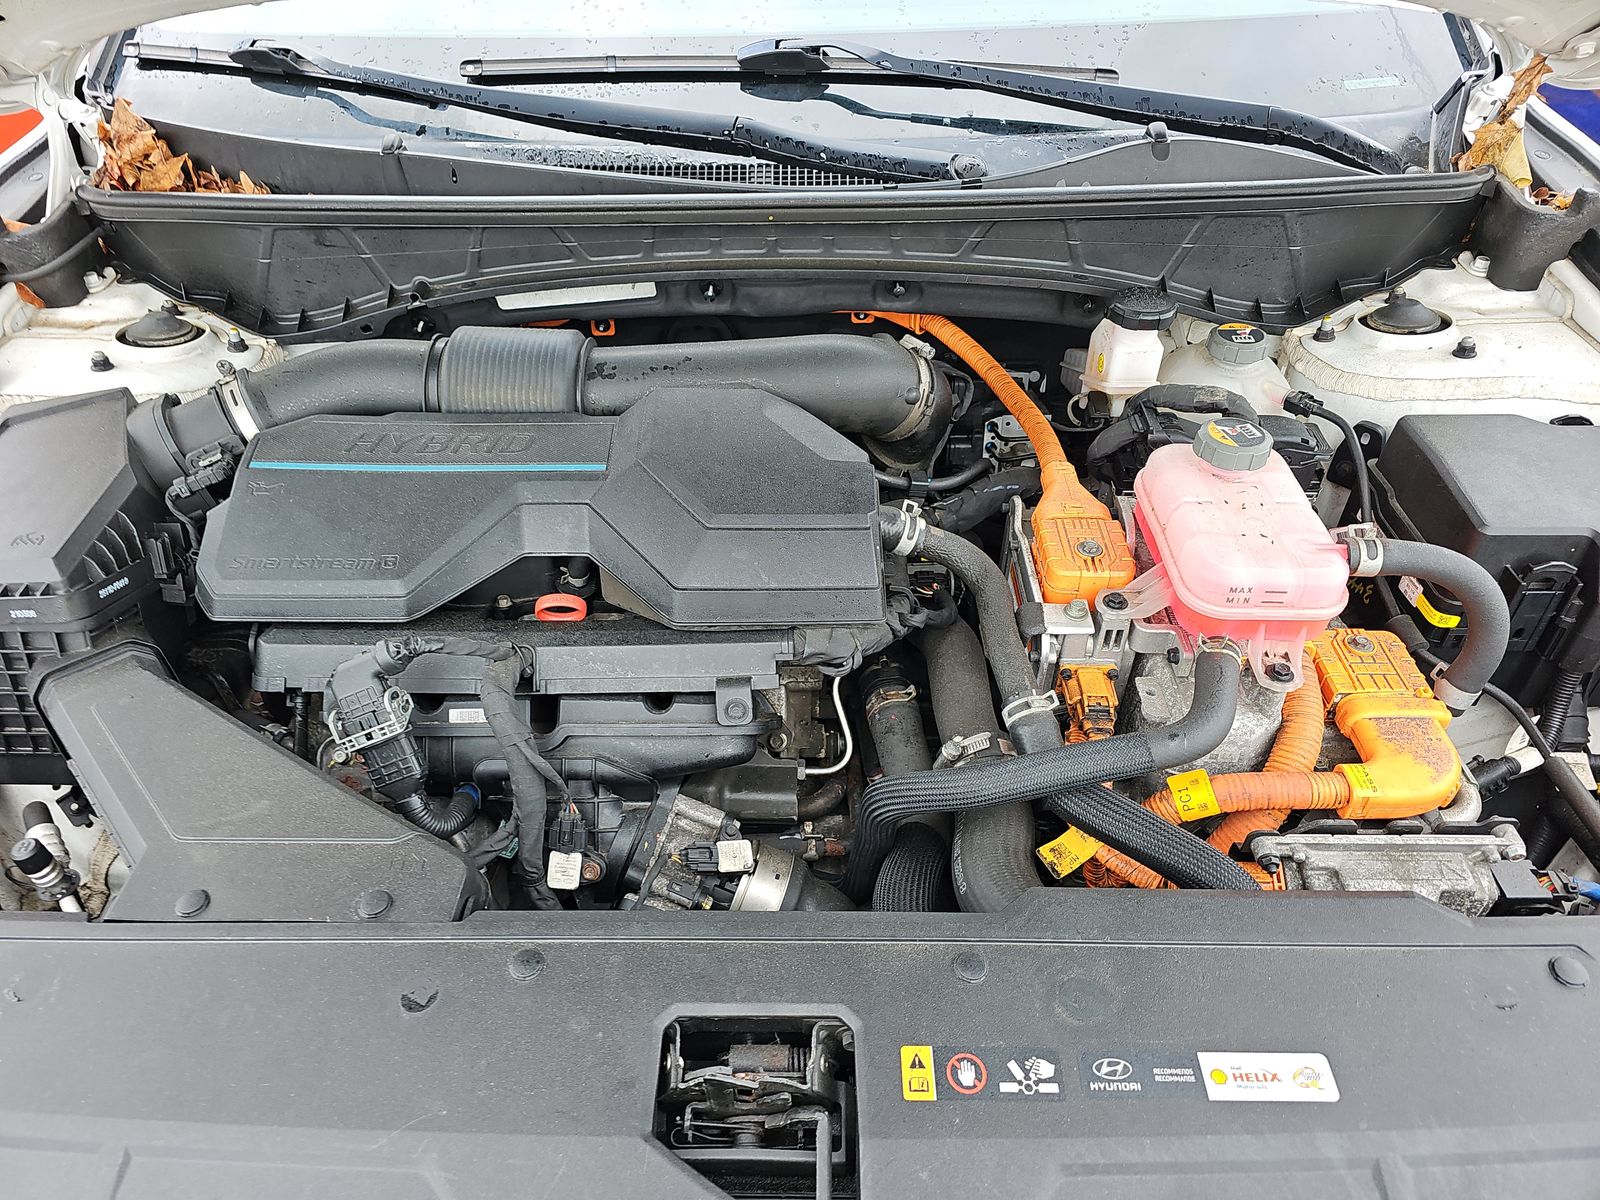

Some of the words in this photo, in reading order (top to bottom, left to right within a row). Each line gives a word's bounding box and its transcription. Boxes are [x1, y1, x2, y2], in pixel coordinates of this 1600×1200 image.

[343, 432, 536, 454] HYBRID
[228, 554, 377, 570] Smartstream
[1229, 586, 1253, 594] MAX
[1176, 786, 1196, 812] PC1
[1153, 1067, 1194, 1075] RECOMMENDS
[1232, 1072, 1282, 1083] HELIX
[1090, 1081, 1142, 1091] HYUNDAI
